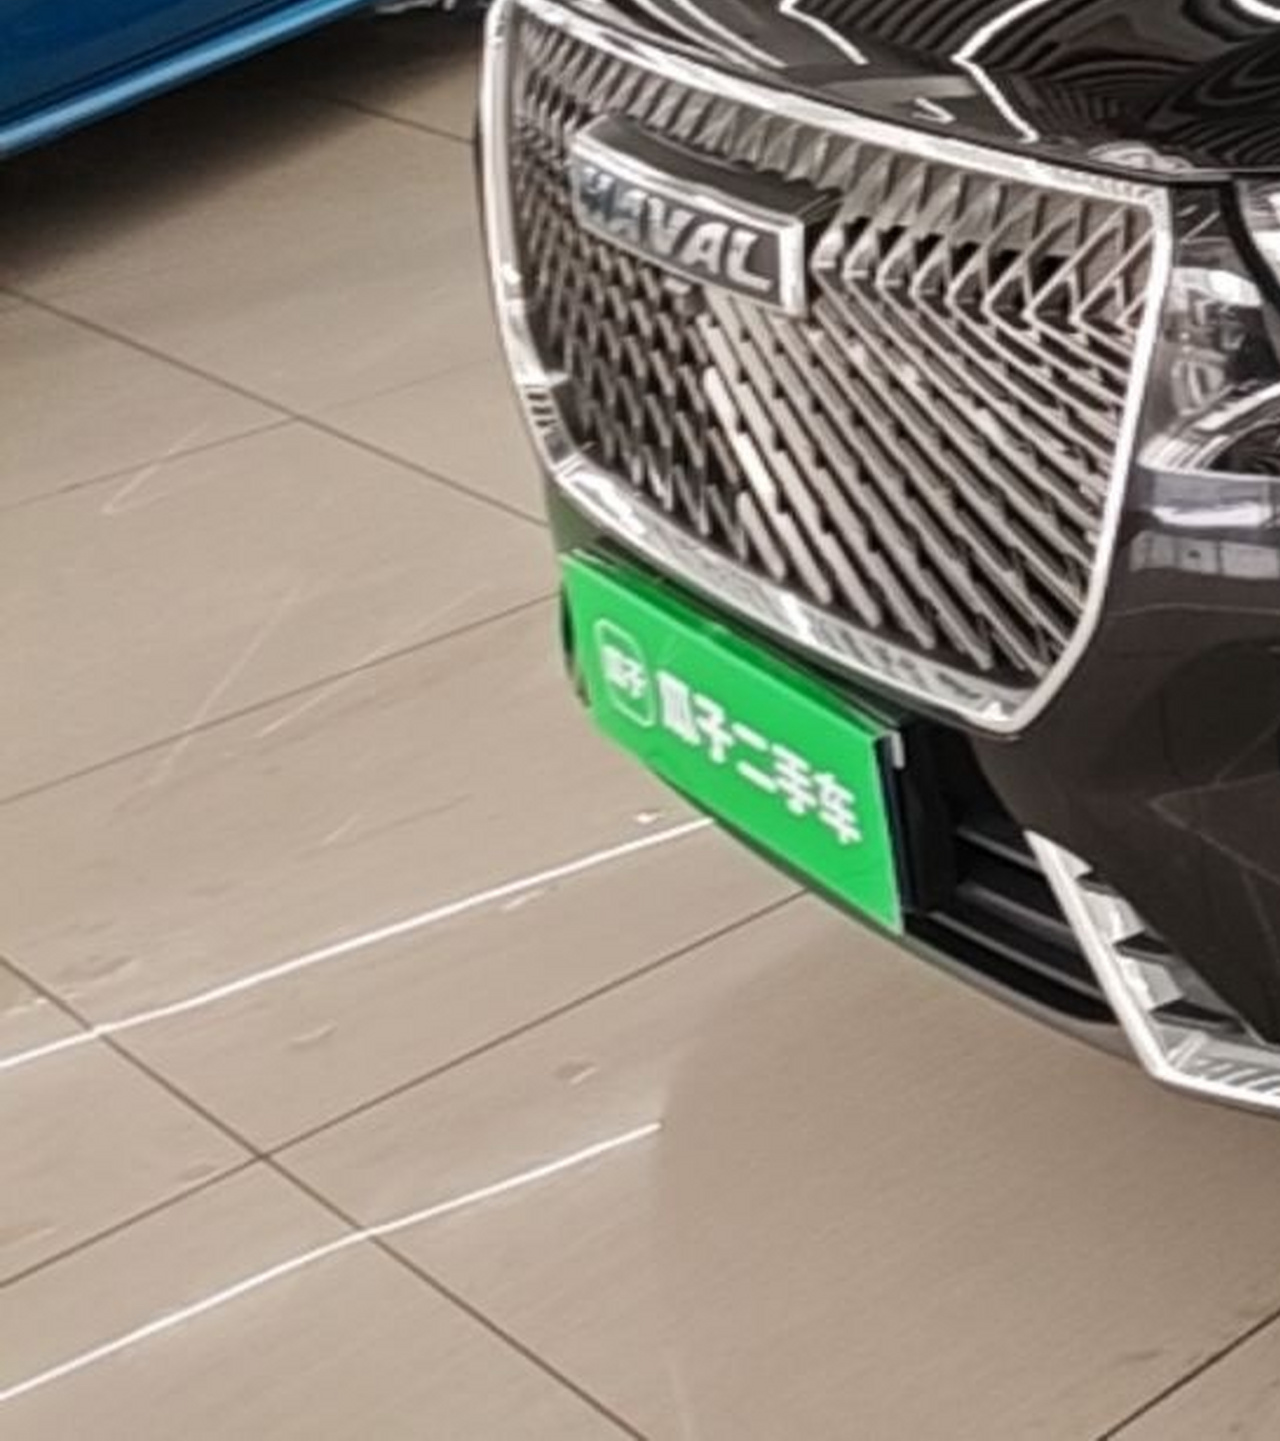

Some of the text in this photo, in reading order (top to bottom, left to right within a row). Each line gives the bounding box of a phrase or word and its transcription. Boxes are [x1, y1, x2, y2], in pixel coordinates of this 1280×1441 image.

[656, 670, 862, 845] 瓜子二手车
